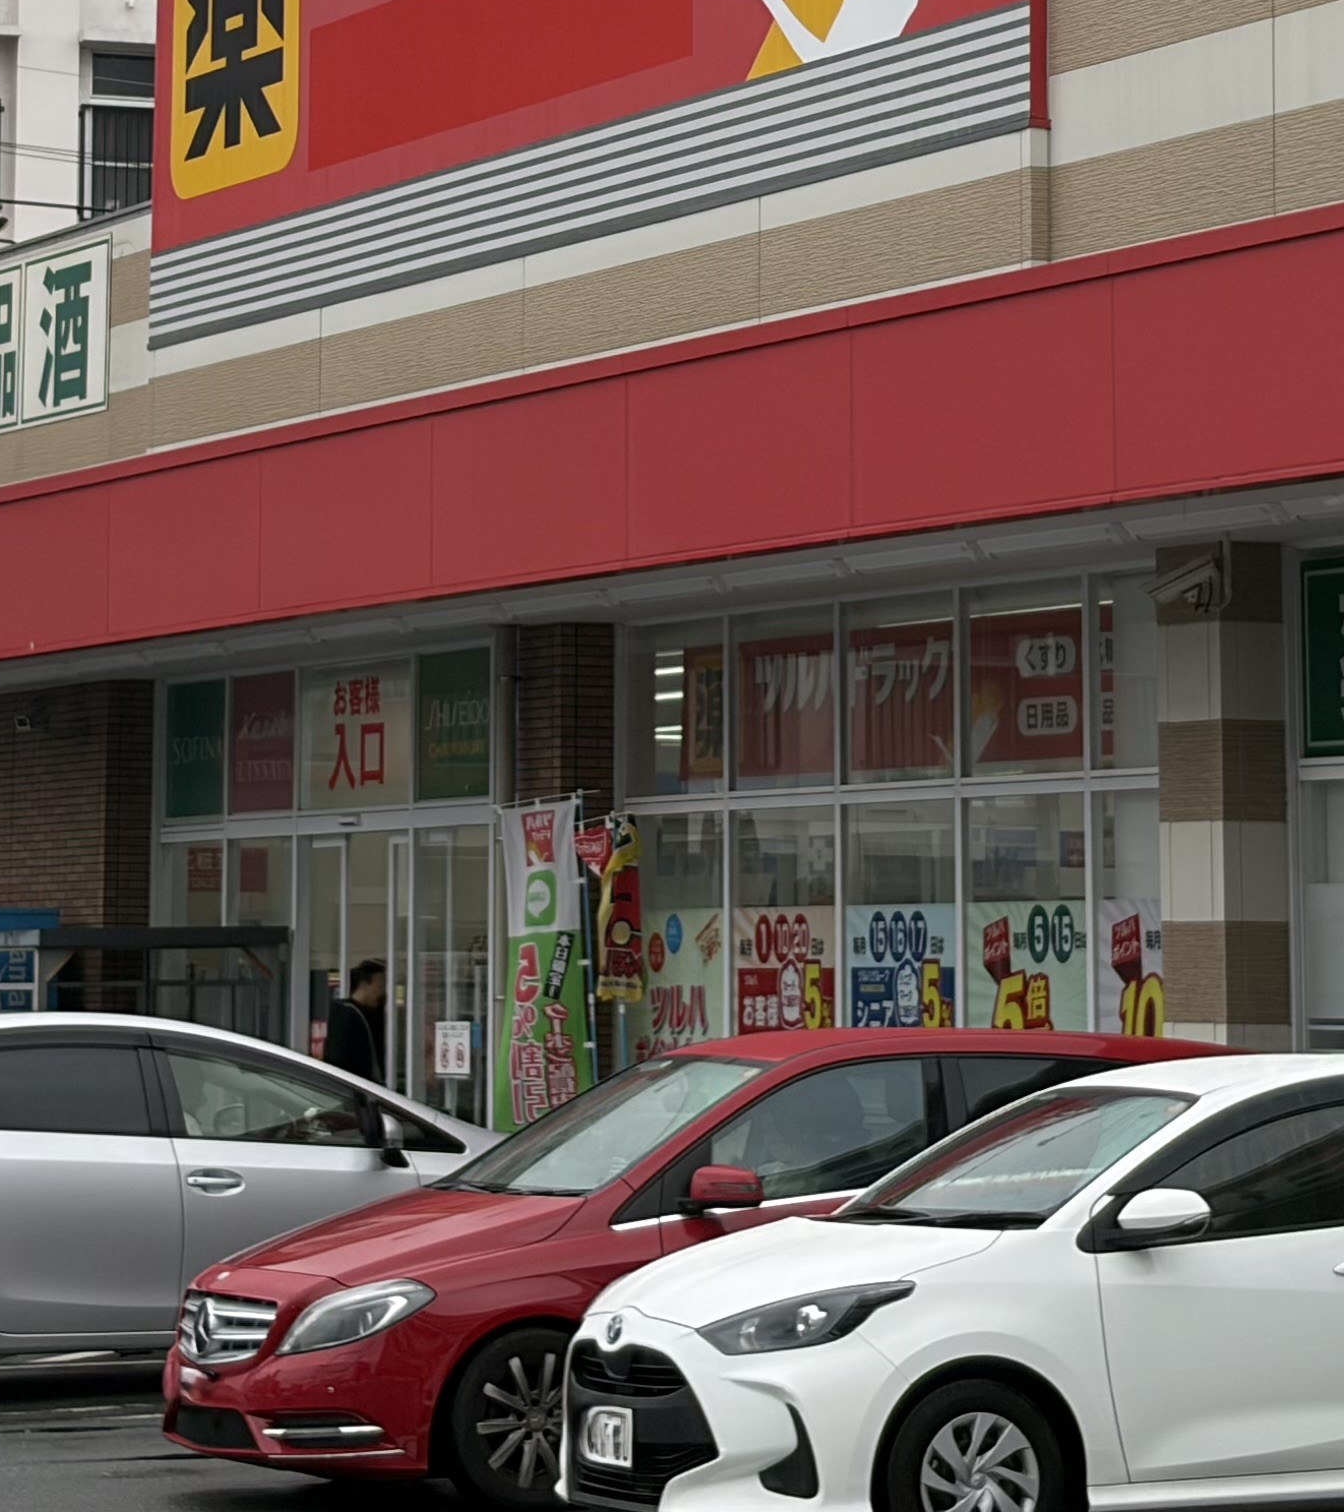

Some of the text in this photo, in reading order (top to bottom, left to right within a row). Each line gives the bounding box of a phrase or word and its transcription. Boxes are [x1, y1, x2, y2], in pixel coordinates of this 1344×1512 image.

[37, 259, 93, 408] 酒
[1022, 639, 1068, 672] くすり
[333, 675, 381, 716] お客様
[1025, 697, 1070, 730] 日用品
[327, 721, 385, 791] 入口
[776, 923, 789, 955] 10
[792, 923, 807, 955] 20
[872, 920, 886, 954] 15
[891, 920, 905, 954] 16
[910, 920, 925, 954] 17
[1034, 915, 1044, 952] 5
[1053, 915, 1071, 953] 15
[650, 984, 708, 1036] ツルハ
[857, 1000, 895, 1028] シニア
